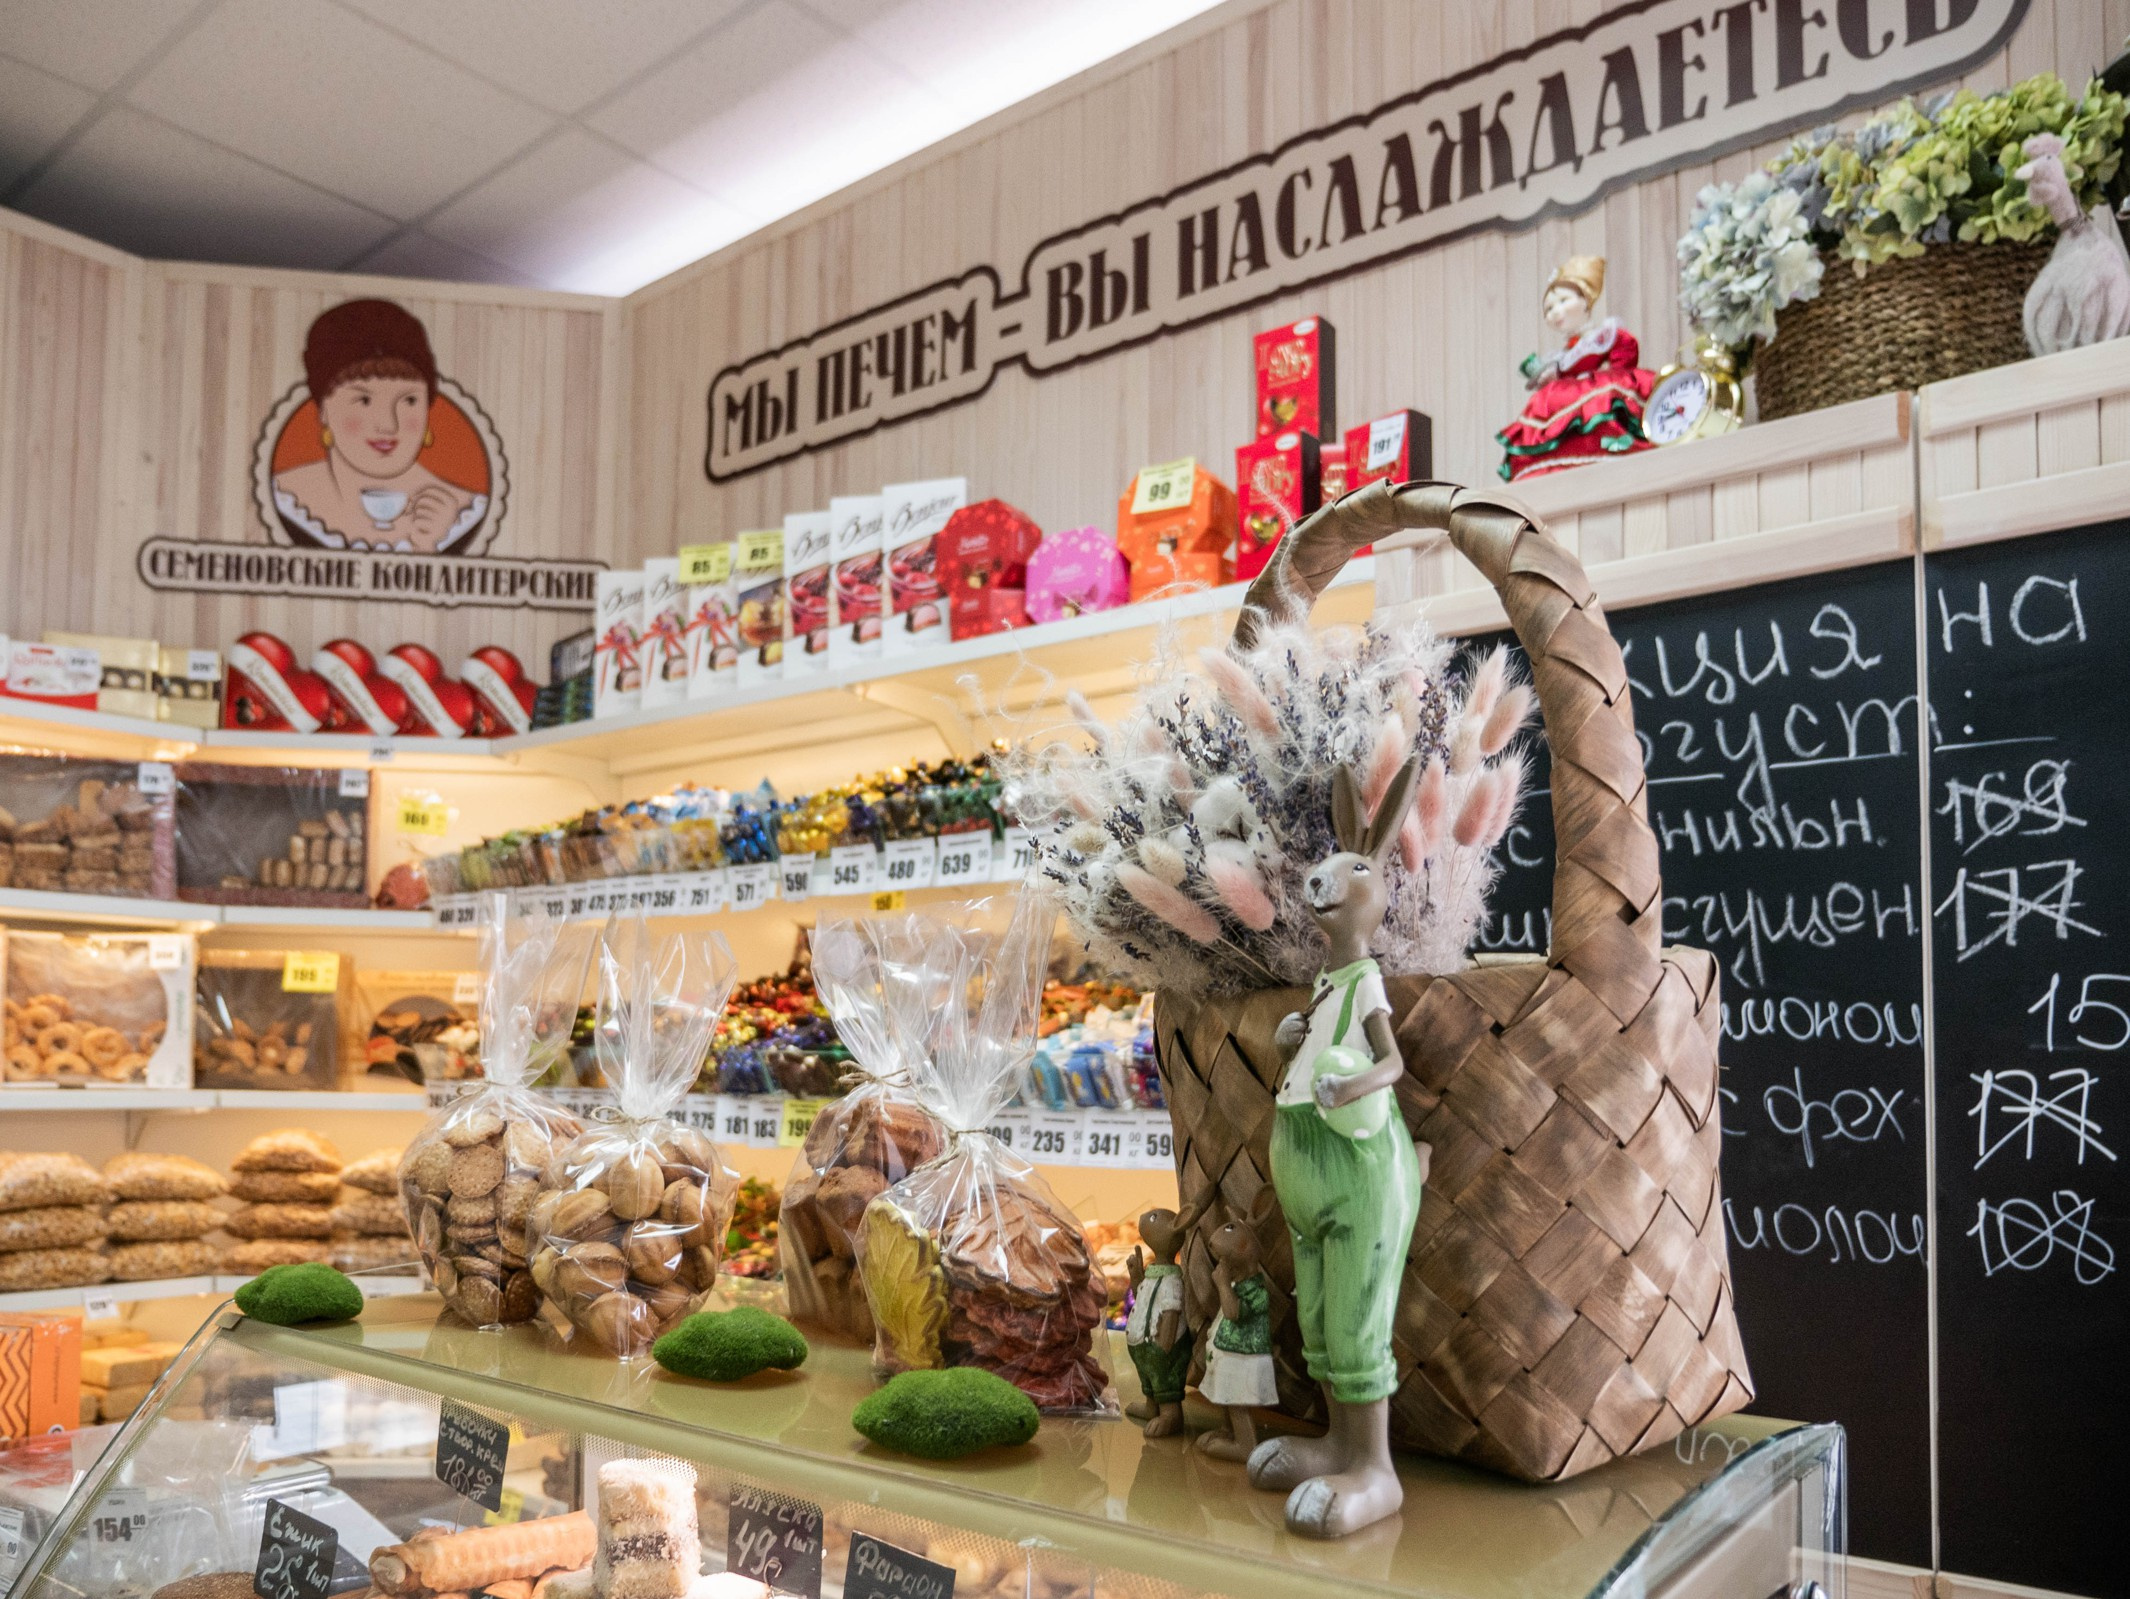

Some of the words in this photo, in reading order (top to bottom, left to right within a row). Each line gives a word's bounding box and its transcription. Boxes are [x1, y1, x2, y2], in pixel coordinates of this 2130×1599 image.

[723, 367, 799, 457] МЫ
[816, 298, 976, 425] ПЕЧЕМ
[1046, 232, 1150, 346] ВЫ
[1149, 481, 1171, 502] 99
[149, 547, 361, 588] СЕМЕНОВСКИЕ
[372, 560, 597, 600] КОНДИТЕРСКИЕ
[1938, 574, 2086, 652] на
[834, 864, 859, 885] 545
[889, 860, 915, 879] 480
[942, 853, 971, 876] 639
[737, 884, 754, 901] 571
[726, 1116, 748, 1135] 181
[755, 1119, 777, 1138] 183
[1033, 1130, 1065, 1153] 235
[1089, 1133, 1121, 1156] 341
[93, 1517, 132, 1542] 154
[133, 1515, 146, 1526] 00
